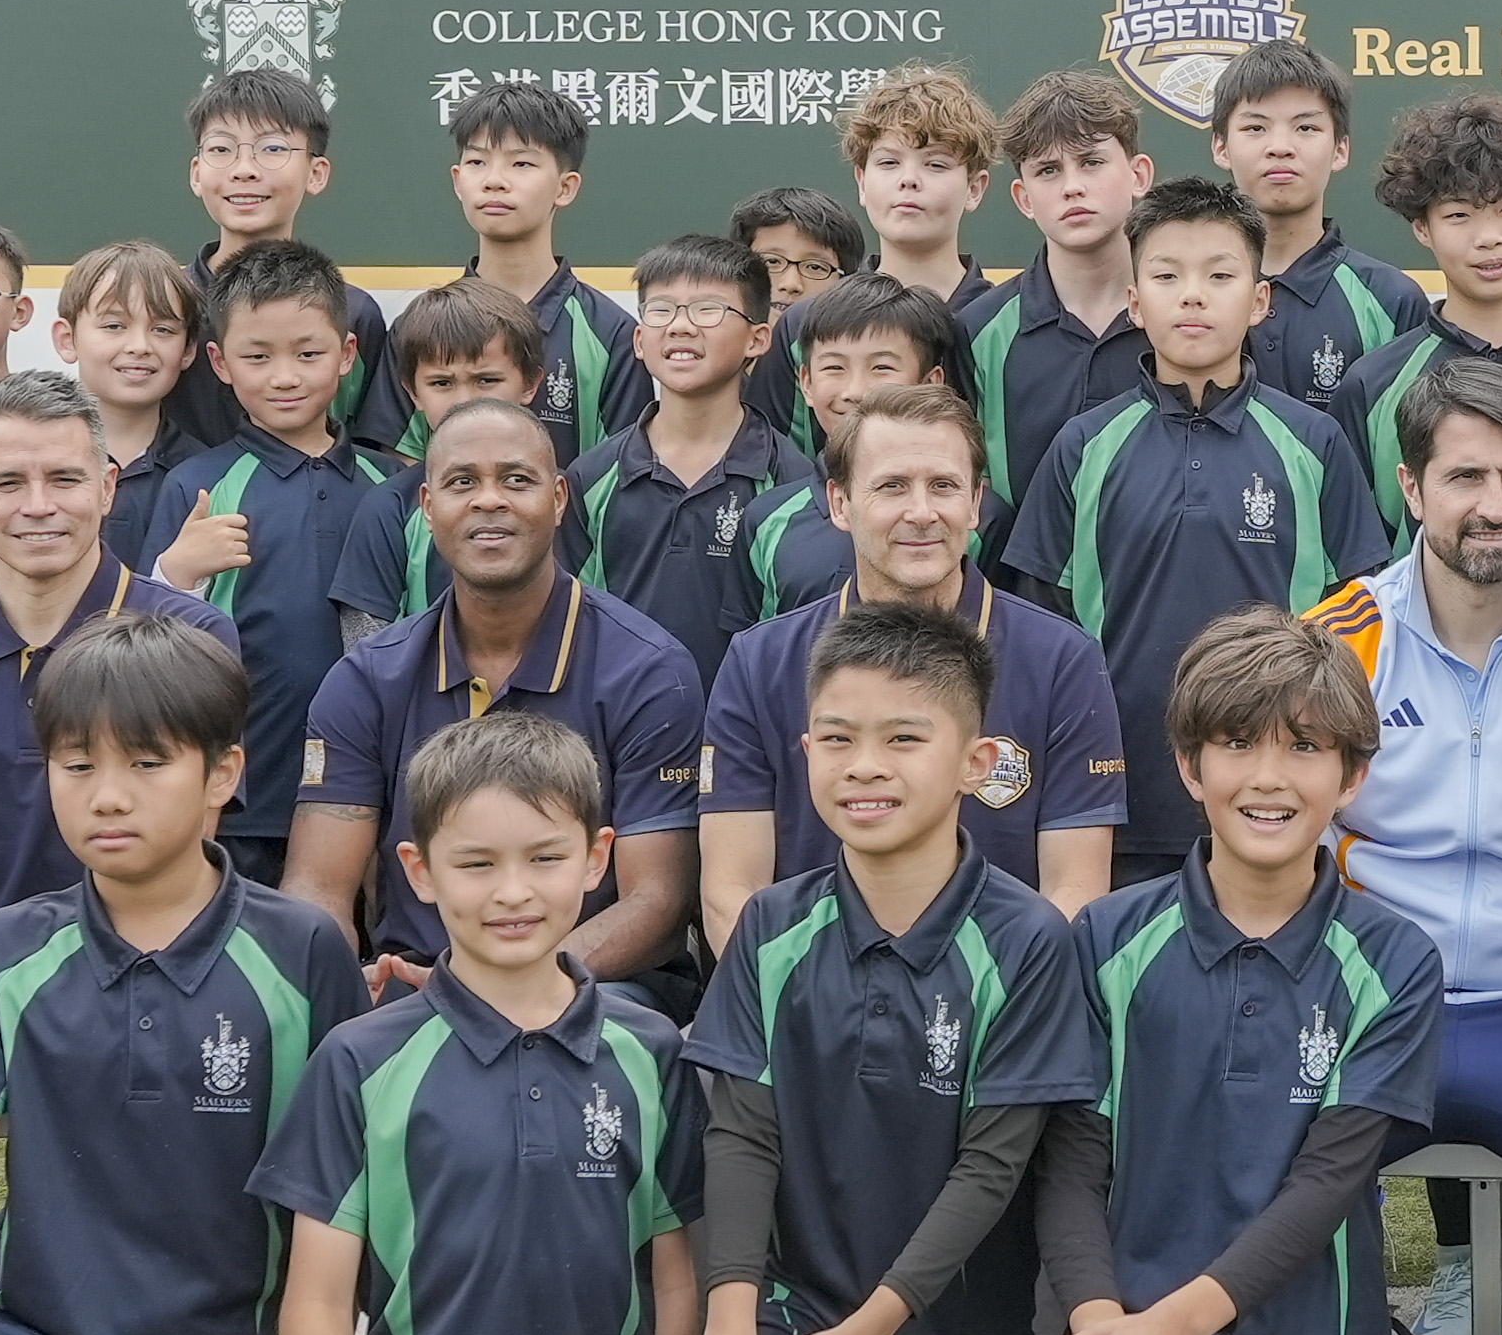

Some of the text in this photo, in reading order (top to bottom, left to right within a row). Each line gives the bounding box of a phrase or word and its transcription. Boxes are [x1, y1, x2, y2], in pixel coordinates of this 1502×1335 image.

[432, 9, 946, 43] COLLEGE HONG KONG
[1109, 8, 1297, 50] ASSEMBLE
[1353, 26, 1483, 77] Real
[193, 1095, 252, 1107] MALVERN
